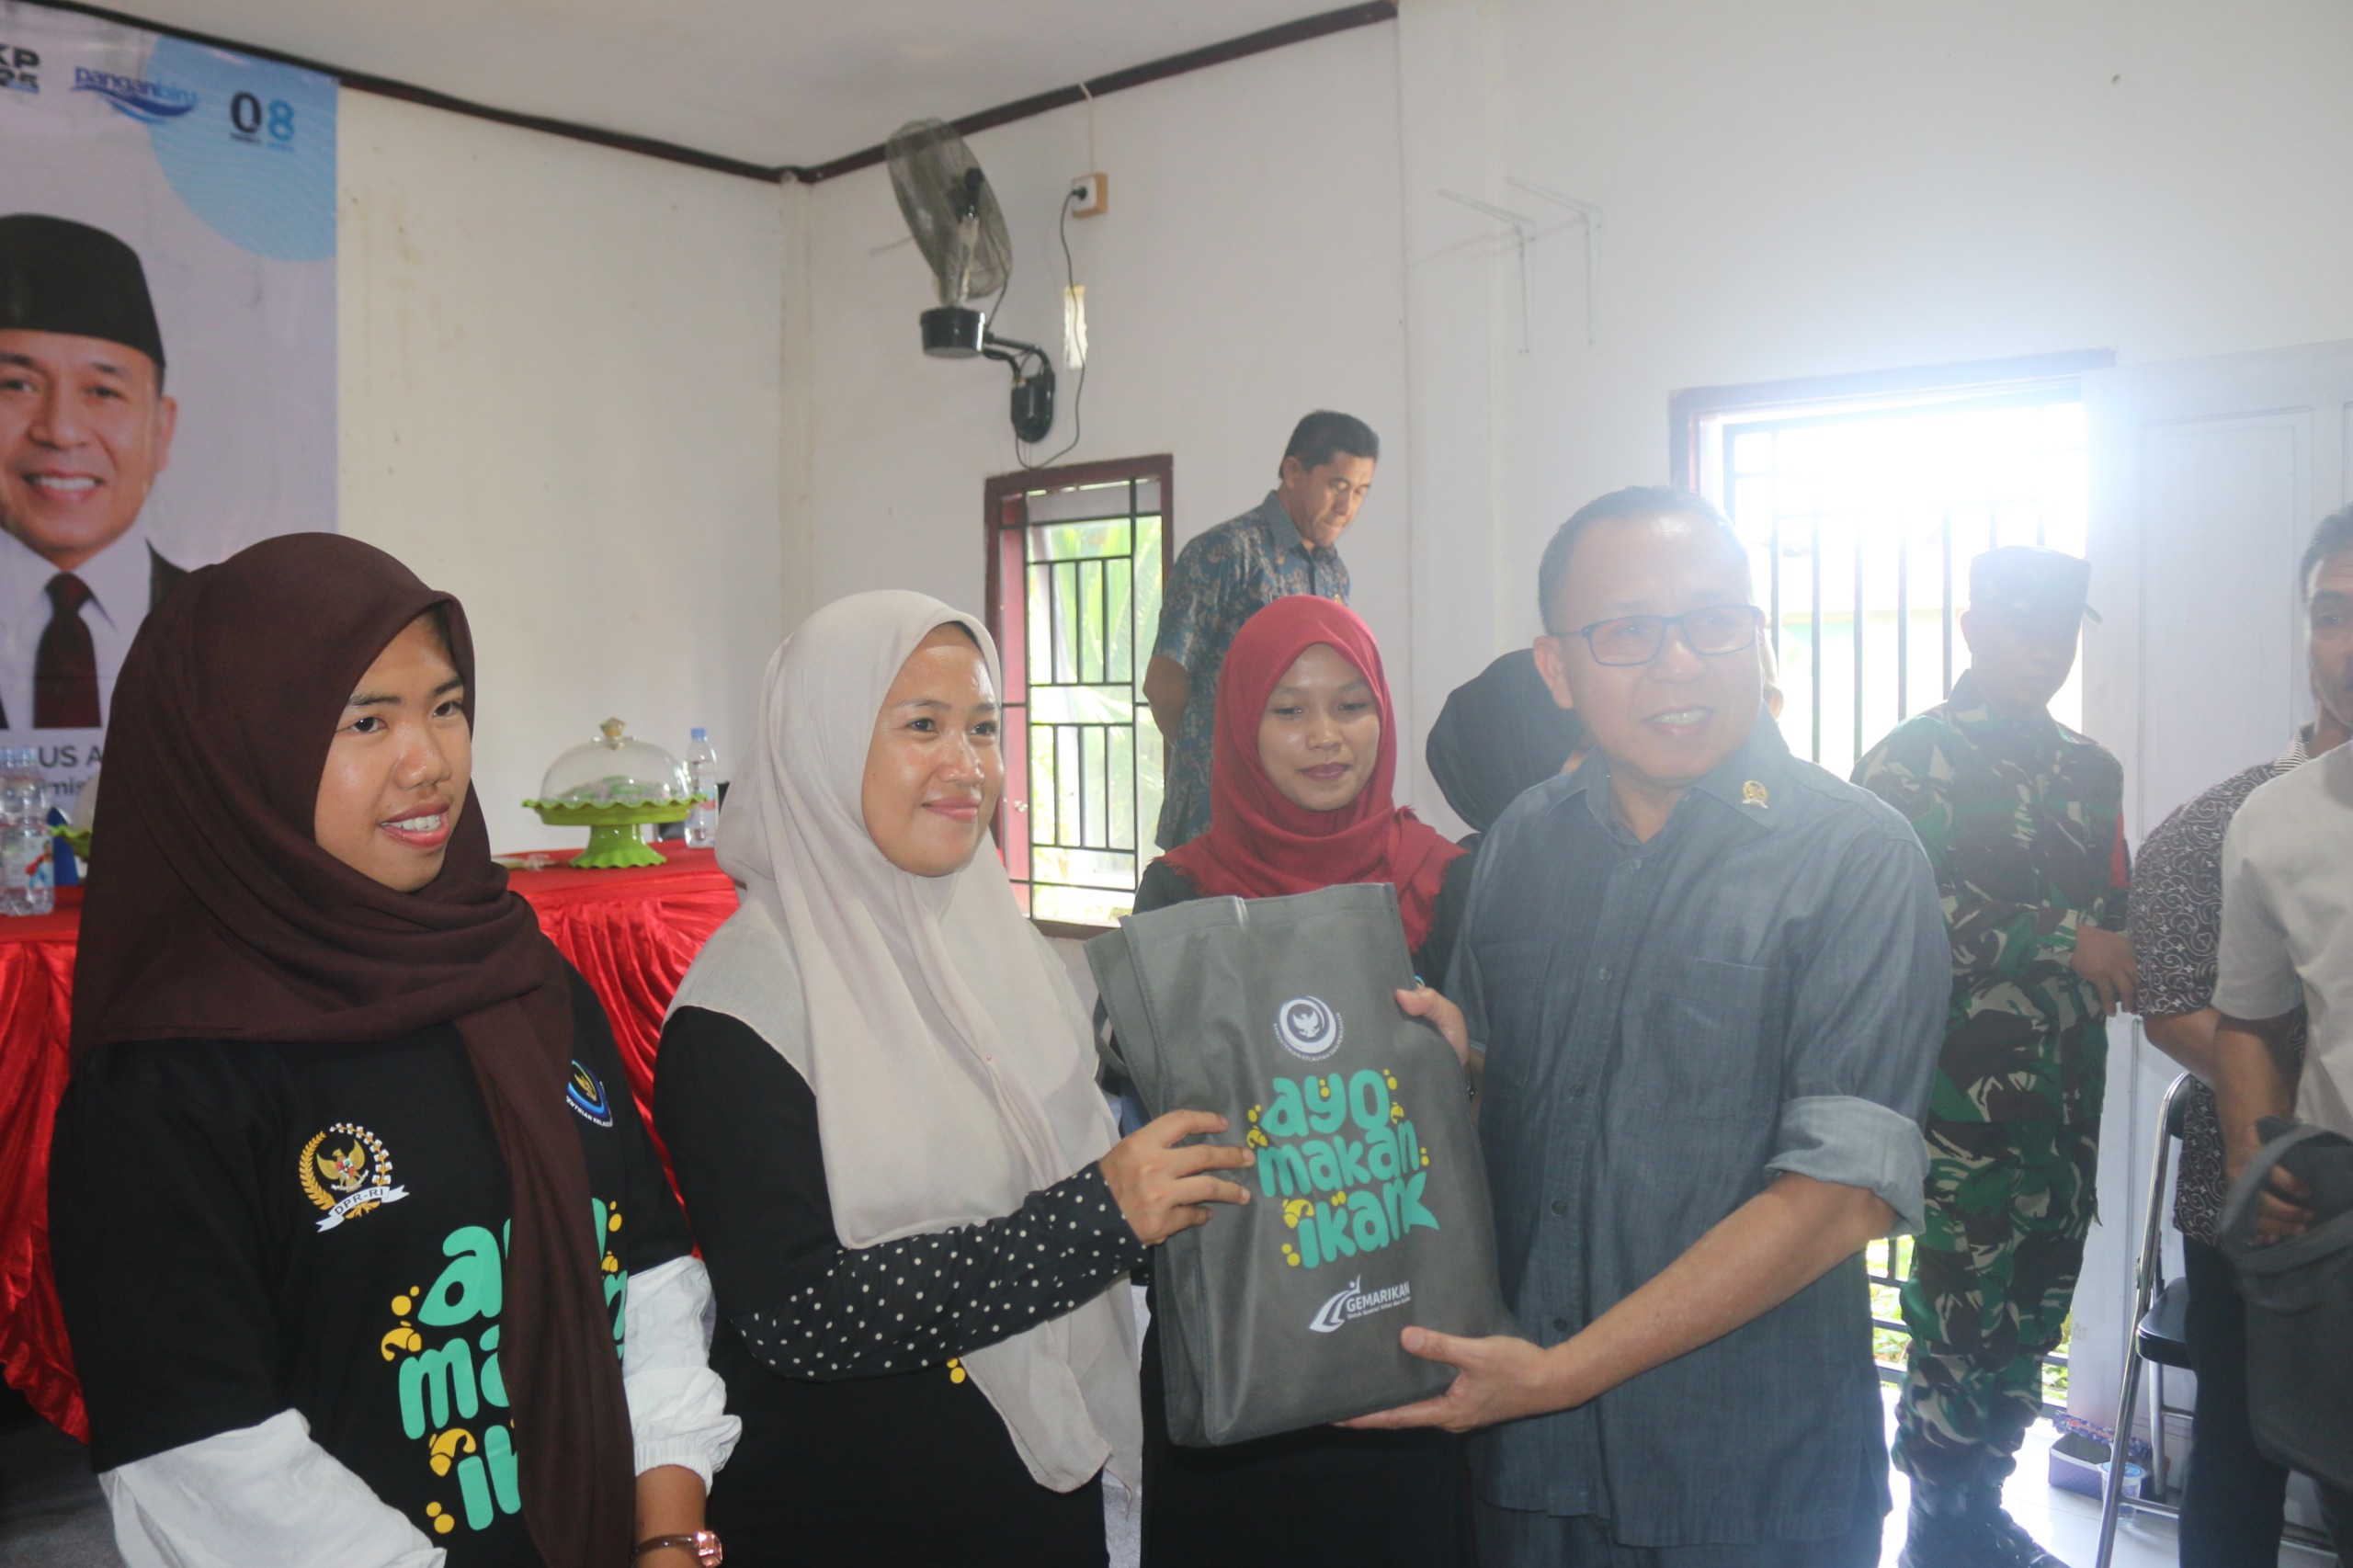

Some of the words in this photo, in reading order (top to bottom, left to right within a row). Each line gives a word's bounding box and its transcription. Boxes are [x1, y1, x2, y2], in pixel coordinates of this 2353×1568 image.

[231, 91, 295, 141] 08
[1260, 1069, 1391, 1138] ayo
[1256, 1119, 1420, 1199] makan
[335, 1188, 383, 1215] DPR-RI
[1347, 1280, 1410, 1312] GEMARIKAN
